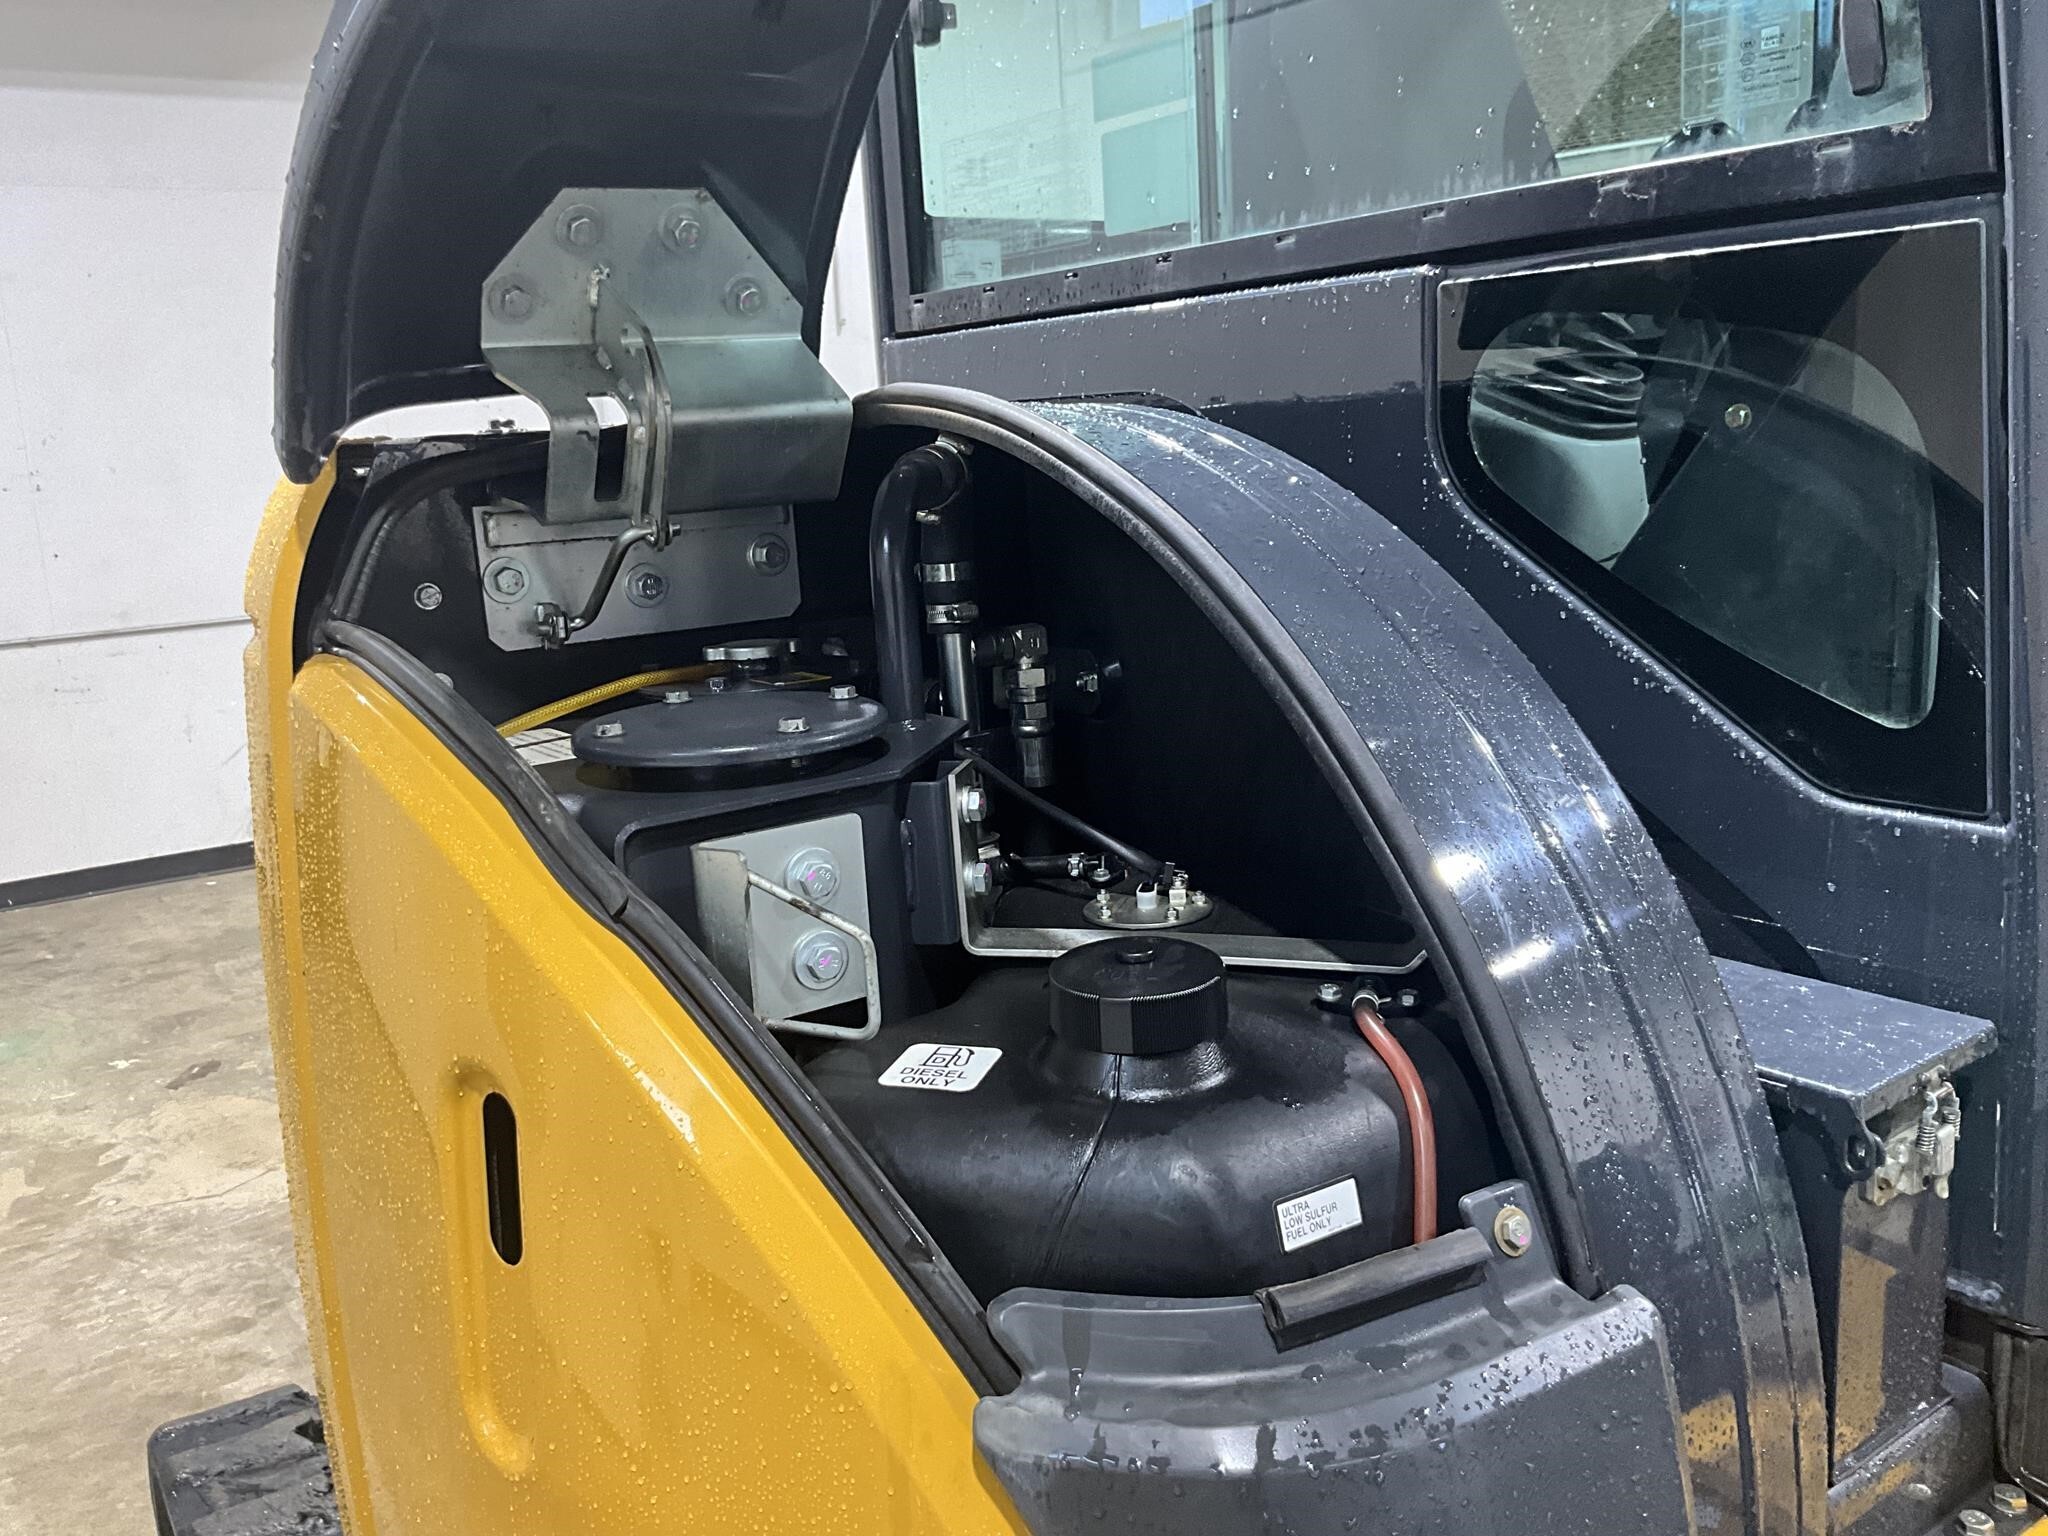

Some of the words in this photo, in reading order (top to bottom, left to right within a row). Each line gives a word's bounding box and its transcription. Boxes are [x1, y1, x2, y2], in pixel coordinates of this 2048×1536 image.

[900, 1066, 967, 1079] DIESEL
[900, 1075, 956, 1087] ONLY
[1281, 1200, 1310, 1218] ULTRA
[1284, 1215, 1303, 1230] LOW
[1305, 1201, 1338, 1222] SULFUR
[1286, 1226, 1308, 1242] FUEL
[1309, 1216, 1331, 1233] ONLY
